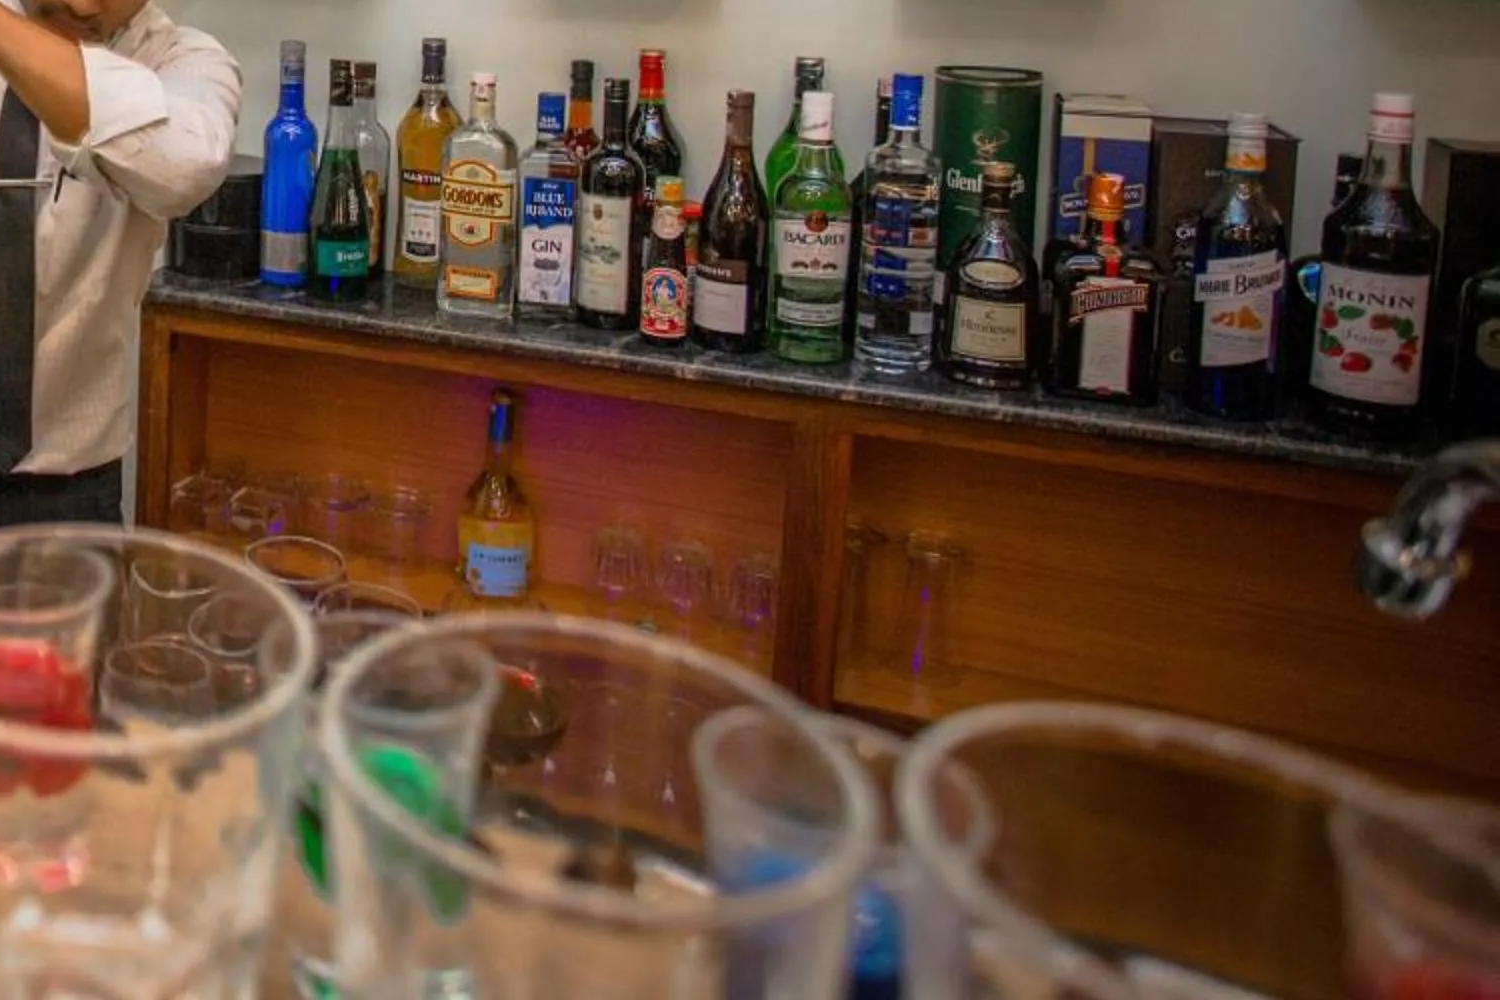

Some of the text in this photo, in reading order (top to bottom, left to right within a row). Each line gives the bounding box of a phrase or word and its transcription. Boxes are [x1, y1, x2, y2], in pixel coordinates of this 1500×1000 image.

[533, 191, 565, 205] BLUE
[531, 238, 563, 253] GIN
[783, 231, 846, 246] BACARDI
[1199, 279, 1230, 294] MARIE
[1328, 284, 1415, 309] MONIN
